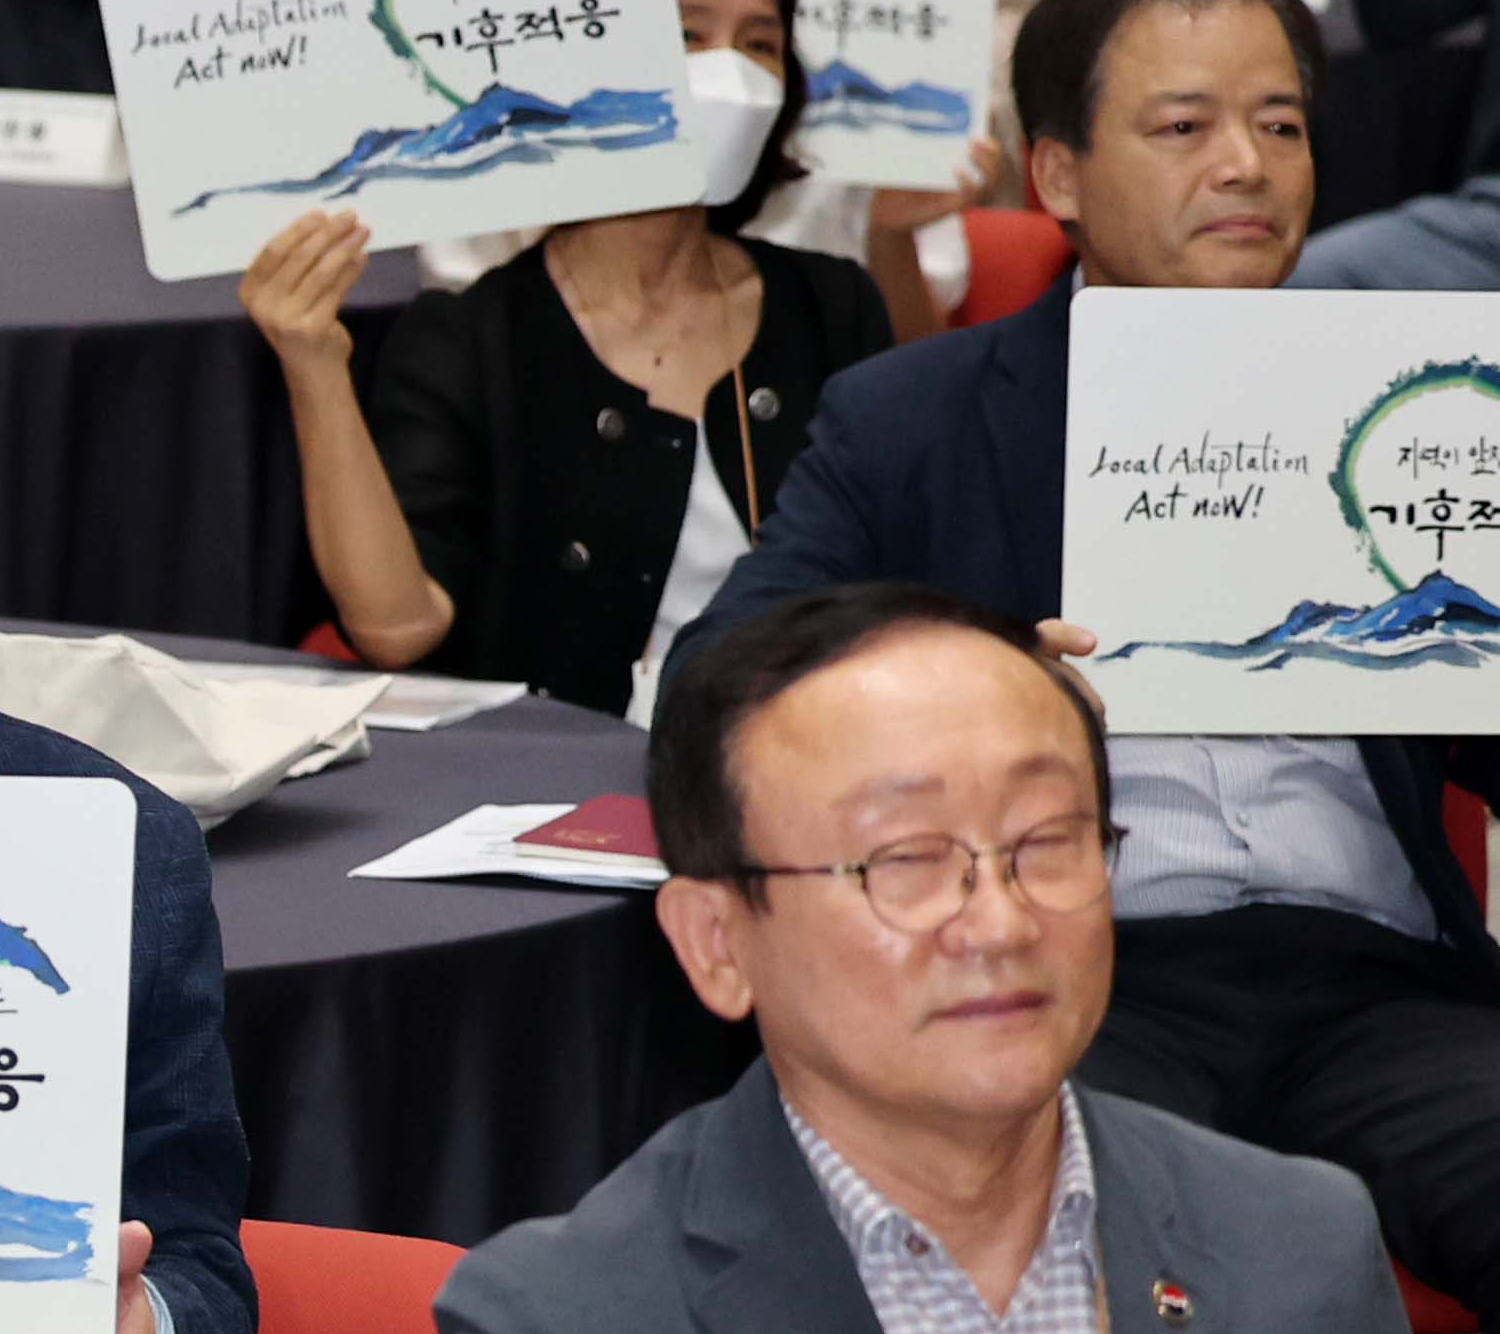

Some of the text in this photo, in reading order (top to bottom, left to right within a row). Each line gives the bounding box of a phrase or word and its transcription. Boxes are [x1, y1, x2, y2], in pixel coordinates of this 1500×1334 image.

[132, 14, 200, 55] Local
[174, 47, 231, 89] Act
[1089, 430, 1310, 489] Local Adaptation
[1398, 436, 1459, 480] 지역이
[1125, 484, 1188, 522] Act
